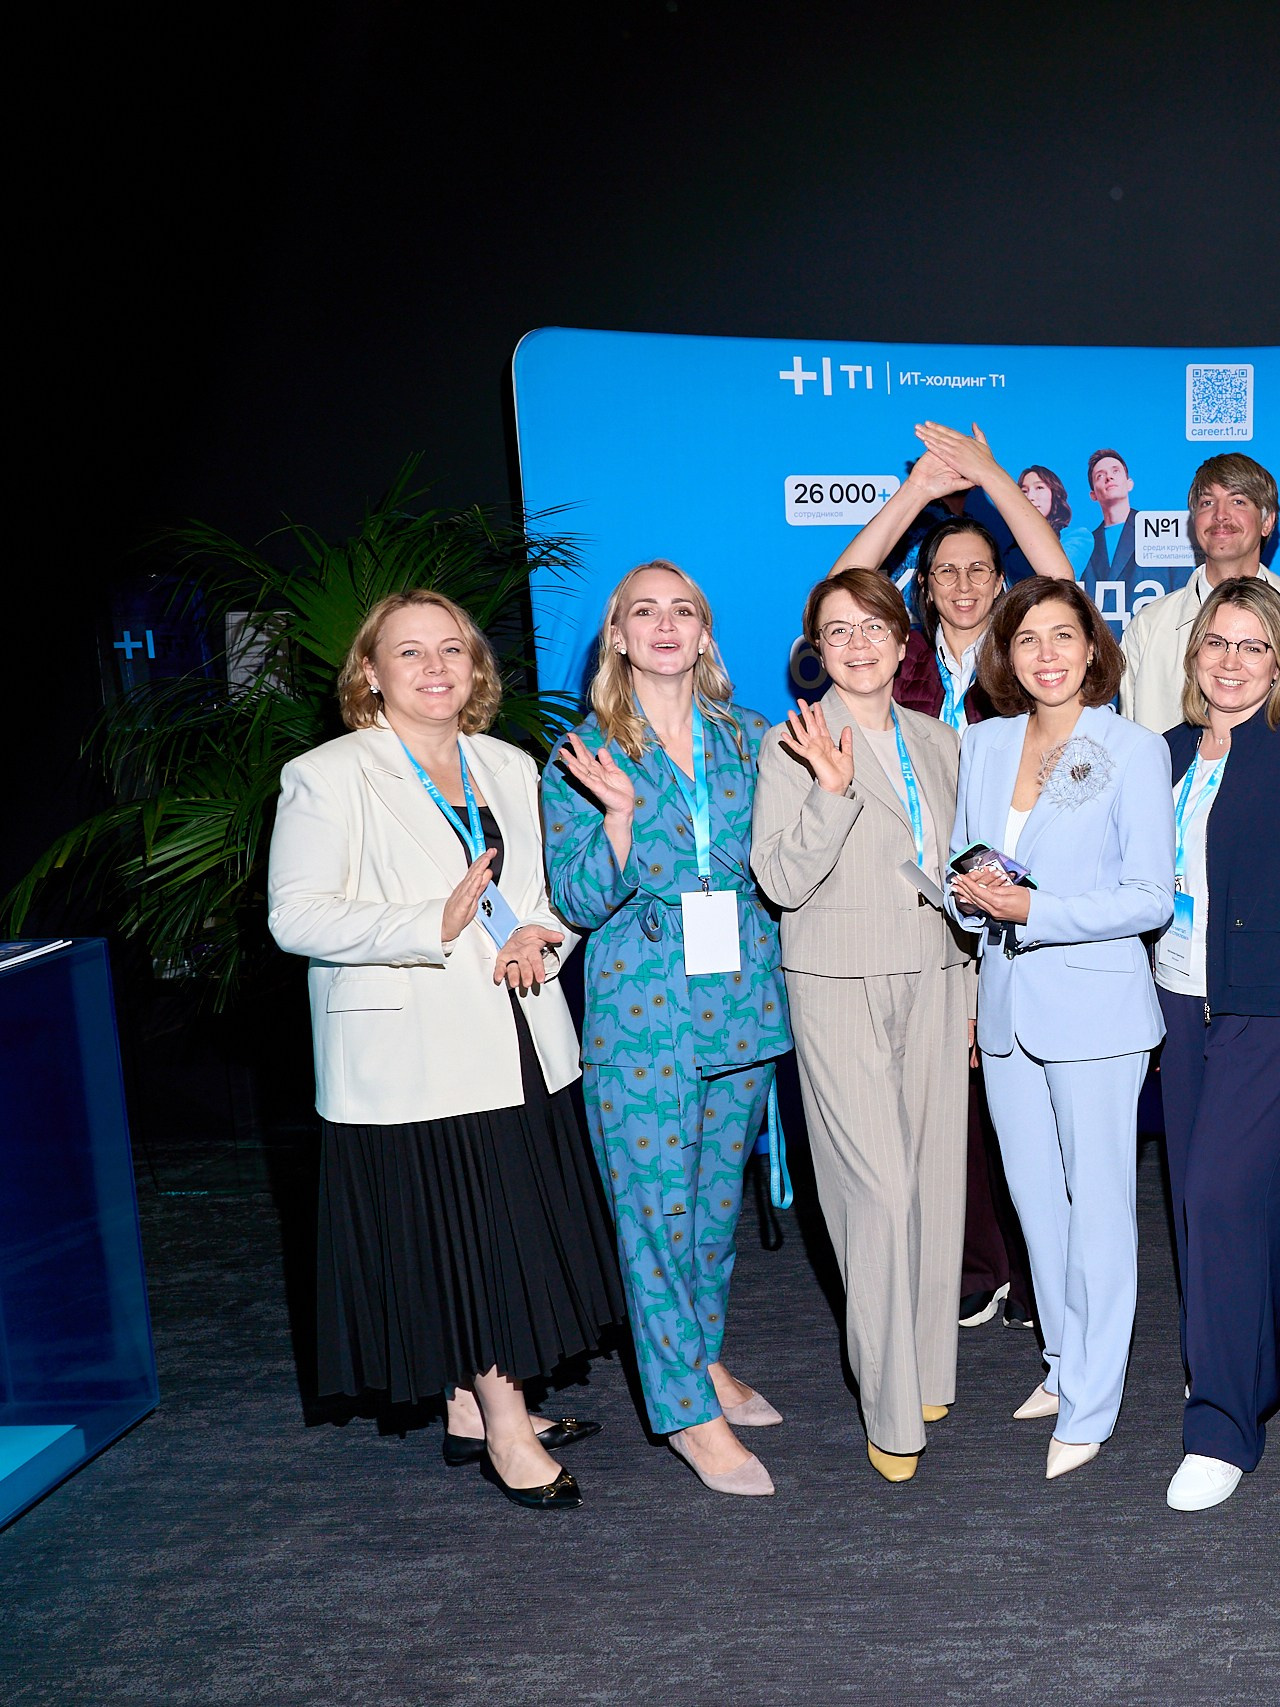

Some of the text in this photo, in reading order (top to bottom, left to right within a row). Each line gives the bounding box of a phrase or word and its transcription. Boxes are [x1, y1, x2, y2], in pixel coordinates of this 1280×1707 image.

[899, 371, 1005, 388] ИТ-холдинг Т1
[1191, 426, 1248, 436] career.t1.ru
[794, 483, 824, 504] 26
[794, 511, 843, 519] сотрудников
[1144, 518, 1179, 538] №1
